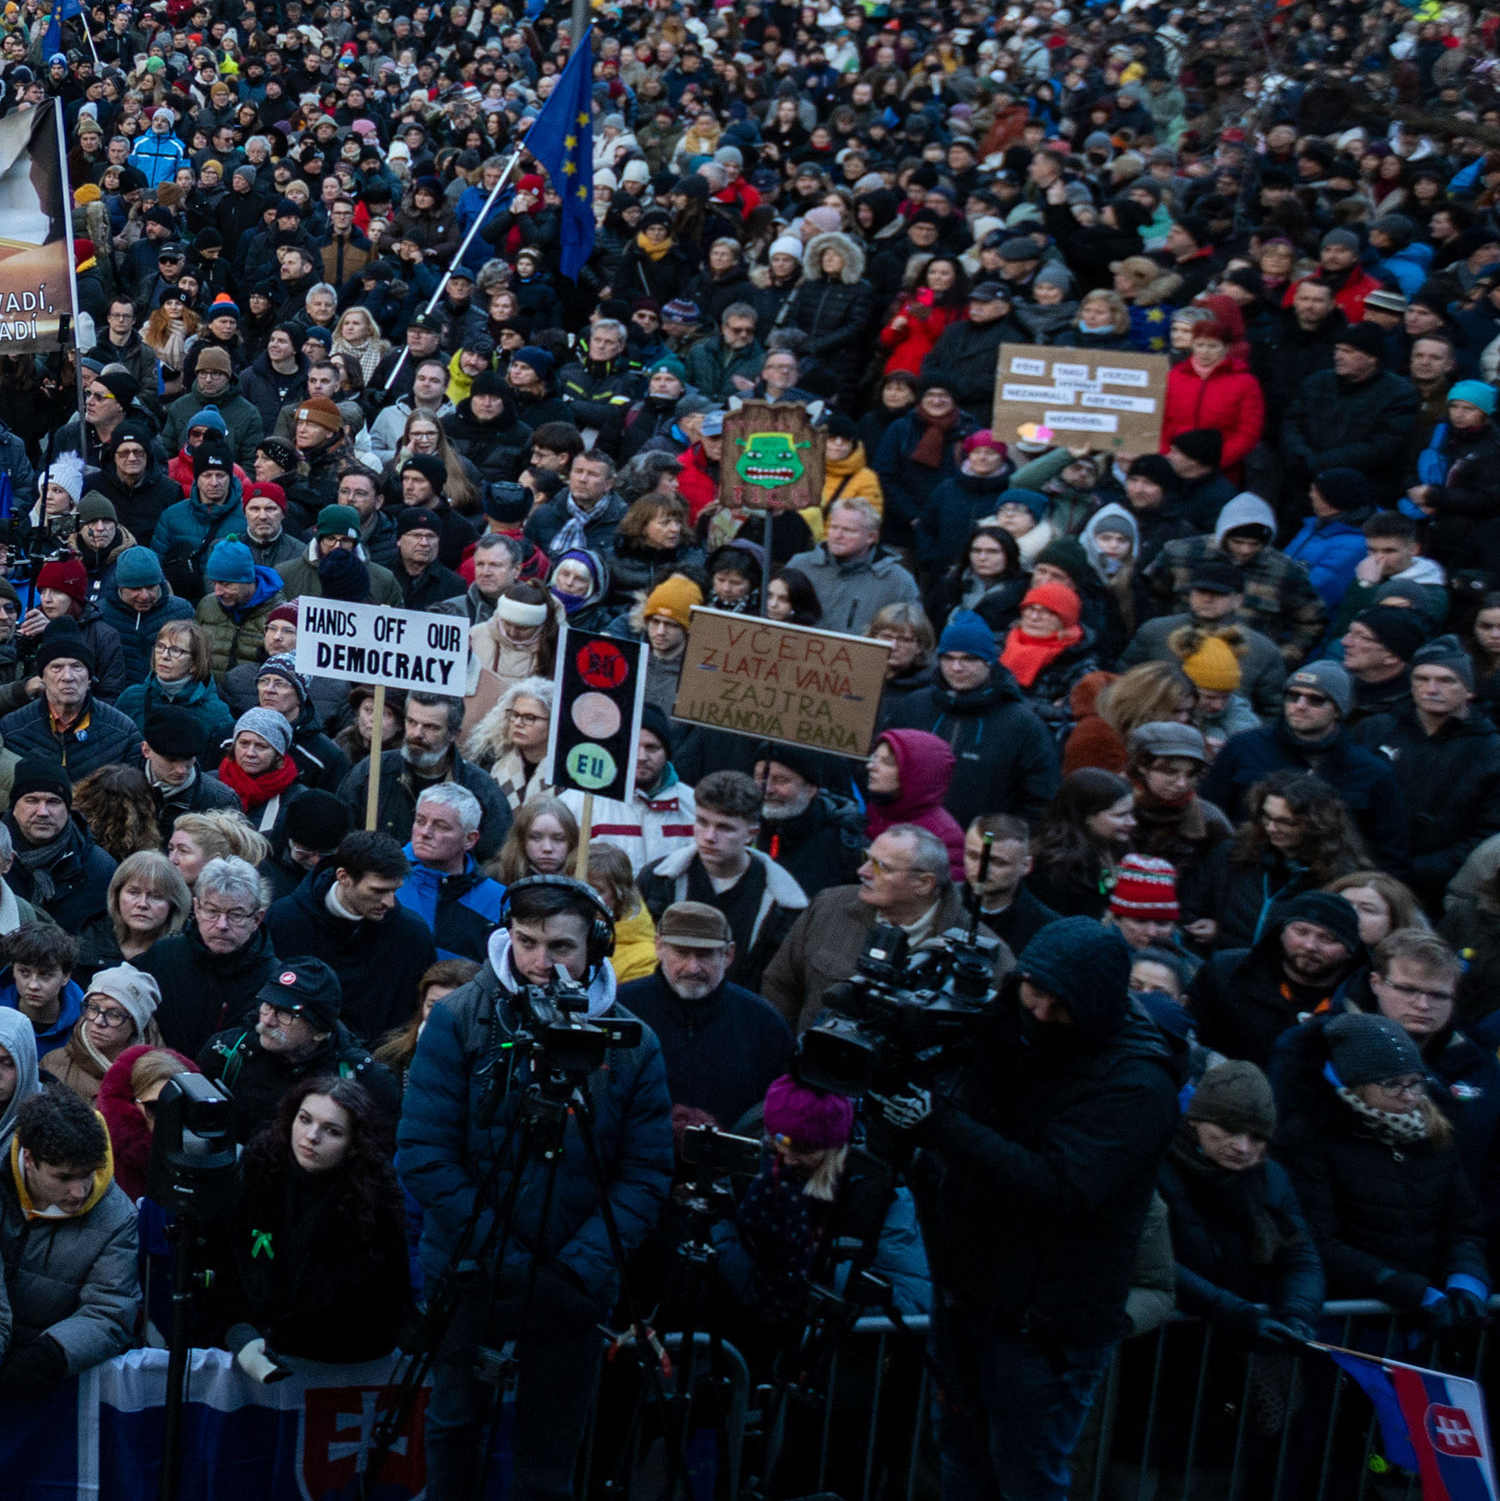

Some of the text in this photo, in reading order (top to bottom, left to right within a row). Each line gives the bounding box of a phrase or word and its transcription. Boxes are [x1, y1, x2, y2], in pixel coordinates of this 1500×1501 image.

[305, 606, 461, 652] HANDS OFF OUR
[728, 624, 854, 672] VČERA
[316, 642, 454, 686] DEMOCRACY
[720, 678, 833, 723] ZAJTRA
[576, 753, 604, 779] EU
